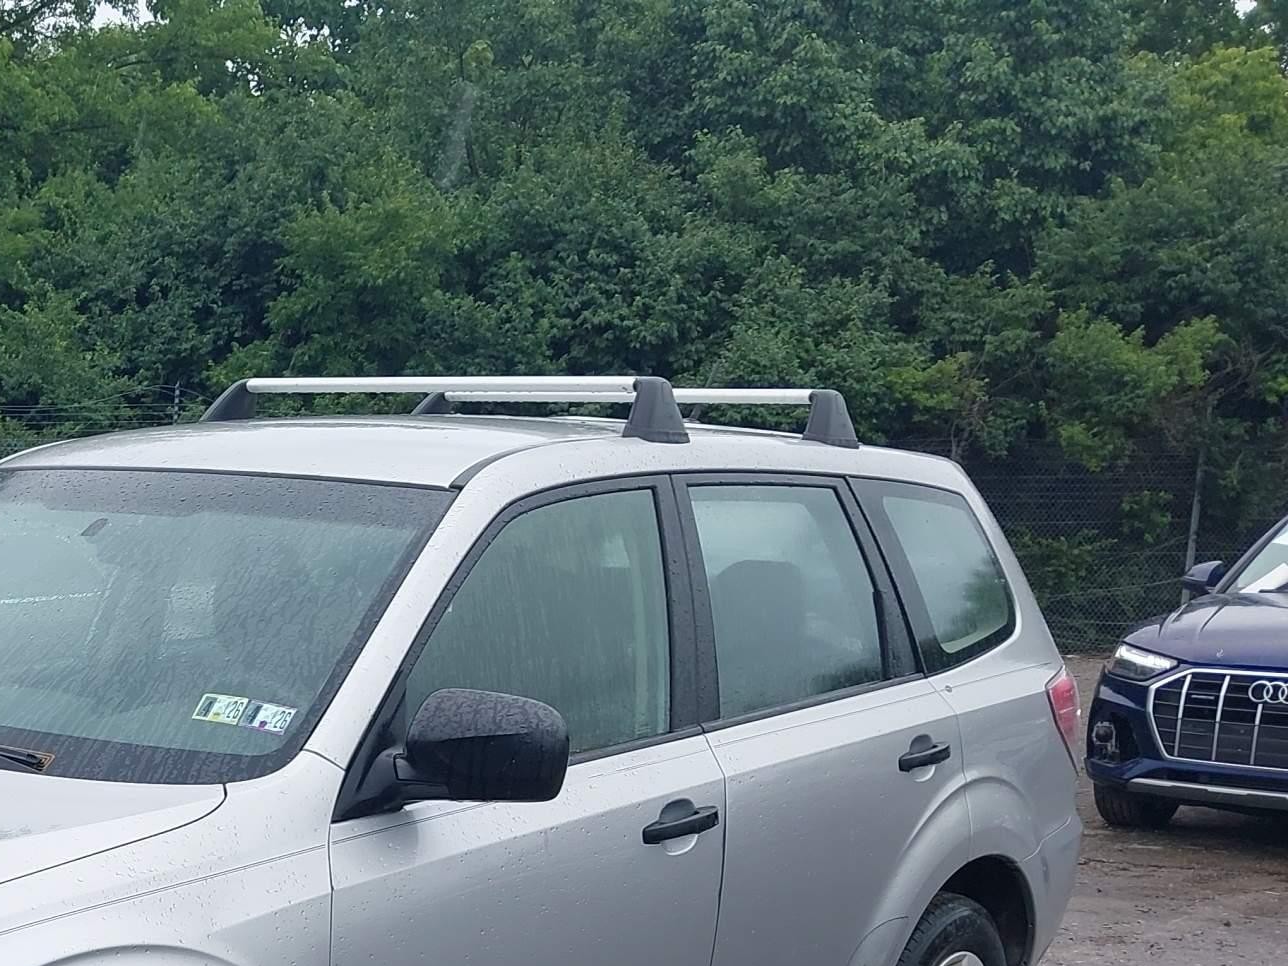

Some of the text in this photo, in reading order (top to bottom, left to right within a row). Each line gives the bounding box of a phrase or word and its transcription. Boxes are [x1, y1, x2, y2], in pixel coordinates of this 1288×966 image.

[200, 700, 245, 720] 4 26
[273, 710, 292, 730] 26
